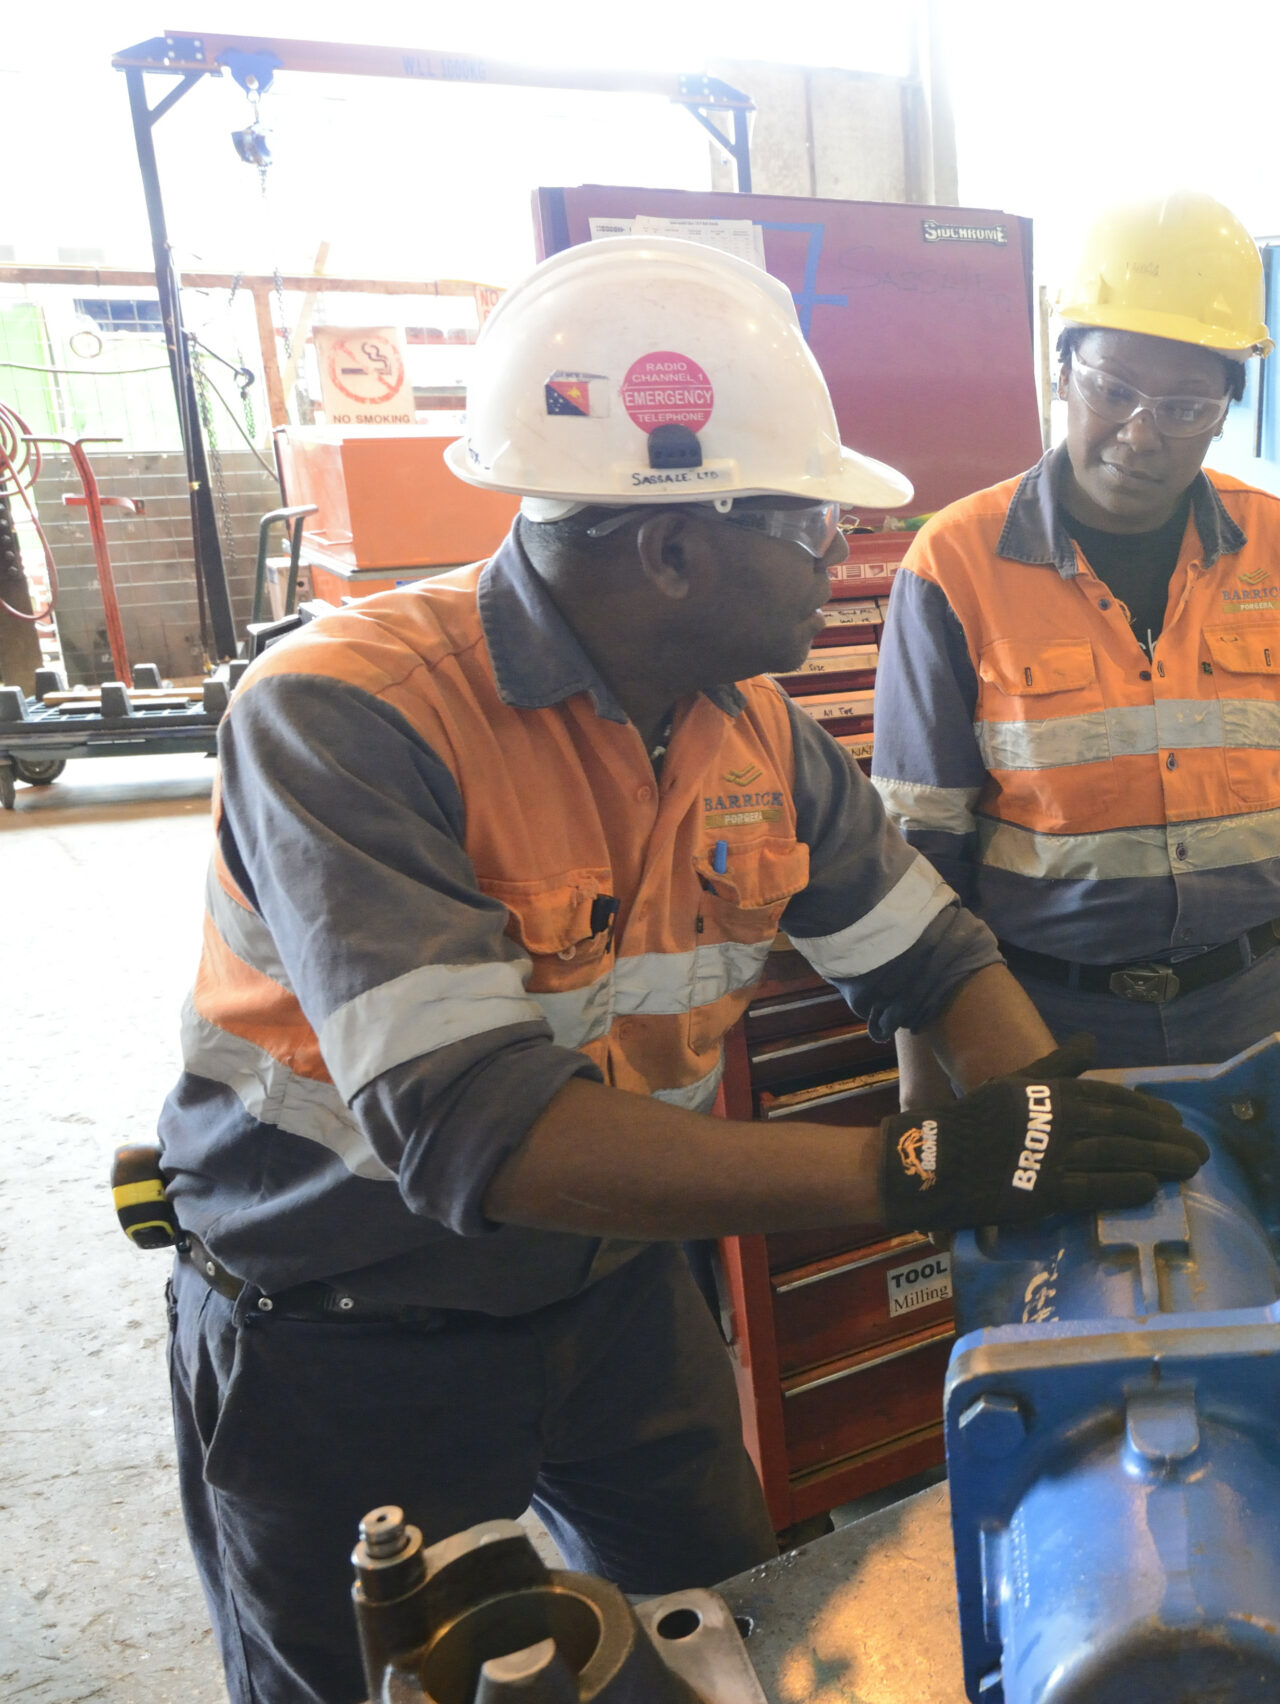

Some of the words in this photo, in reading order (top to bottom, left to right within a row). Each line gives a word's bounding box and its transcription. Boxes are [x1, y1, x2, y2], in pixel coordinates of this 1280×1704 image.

[923, 220, 1008, 243] SIDCHROME
[631, 373, 695, 383] CHANNEL
[698, 372, 704, 382] 1
[645, 362, 688, 372] RADIO
[624, 390, 713, 406] EMERGENCY
[333, 414, 351, 424] NO
[355, 413, 411, 424] SMOKING
[636, 412, 705, 423] TELEPHONE
[703, 791, 784, 812] BARRICK
[920, 1119, 938, 1171] BRONCO
[1012, 1084, 1054, 1191] BRONCO
[891, 1260, 948, 1289] TOOL
[893, 1285, 949, 1312] Milling
